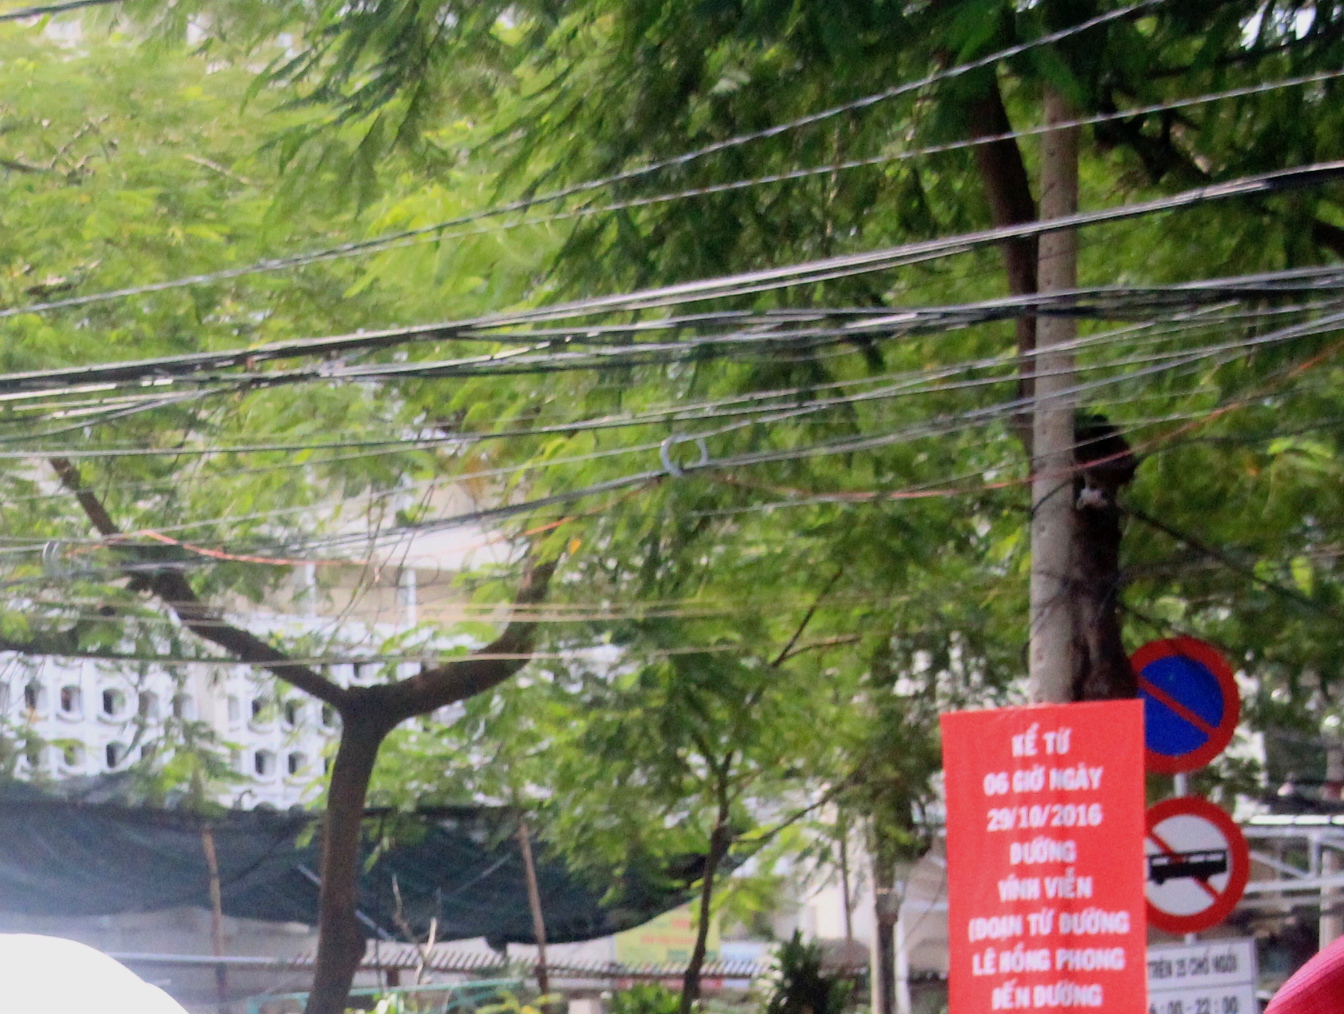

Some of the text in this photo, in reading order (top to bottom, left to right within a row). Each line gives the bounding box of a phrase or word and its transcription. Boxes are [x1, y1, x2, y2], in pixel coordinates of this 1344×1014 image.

[983, 771, 1009, 796] 06
[986, 803, 1103, 832] 29/10/2016
[1056, 947, 1126, 971] PHONG
